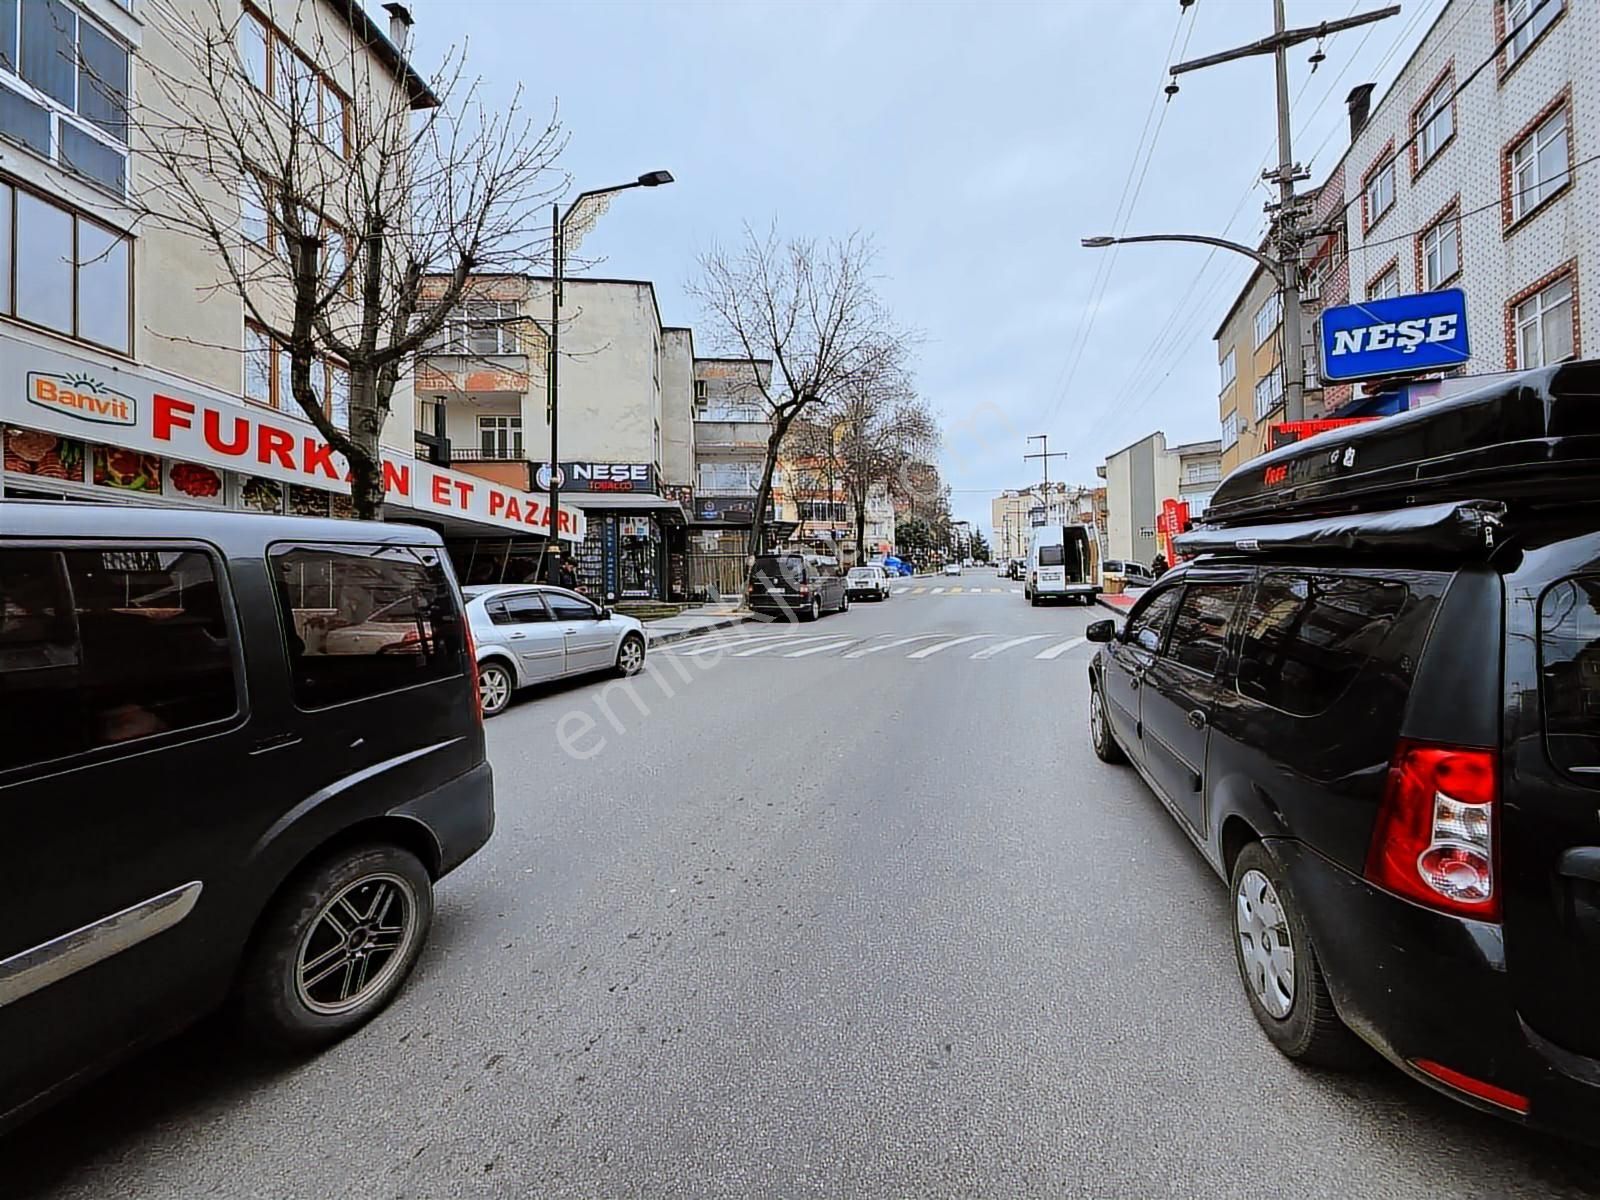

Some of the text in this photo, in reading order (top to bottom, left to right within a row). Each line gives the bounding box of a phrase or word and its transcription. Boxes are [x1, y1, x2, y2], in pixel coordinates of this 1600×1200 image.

[1331, 313, 1458, 354] NEŞE
[35, 378, 129, 420] Banvit
[152, 393, 410, 496] FURKN
[431, 474, 474, 510] ET
[572, 464, 648, 482] NEŞE
